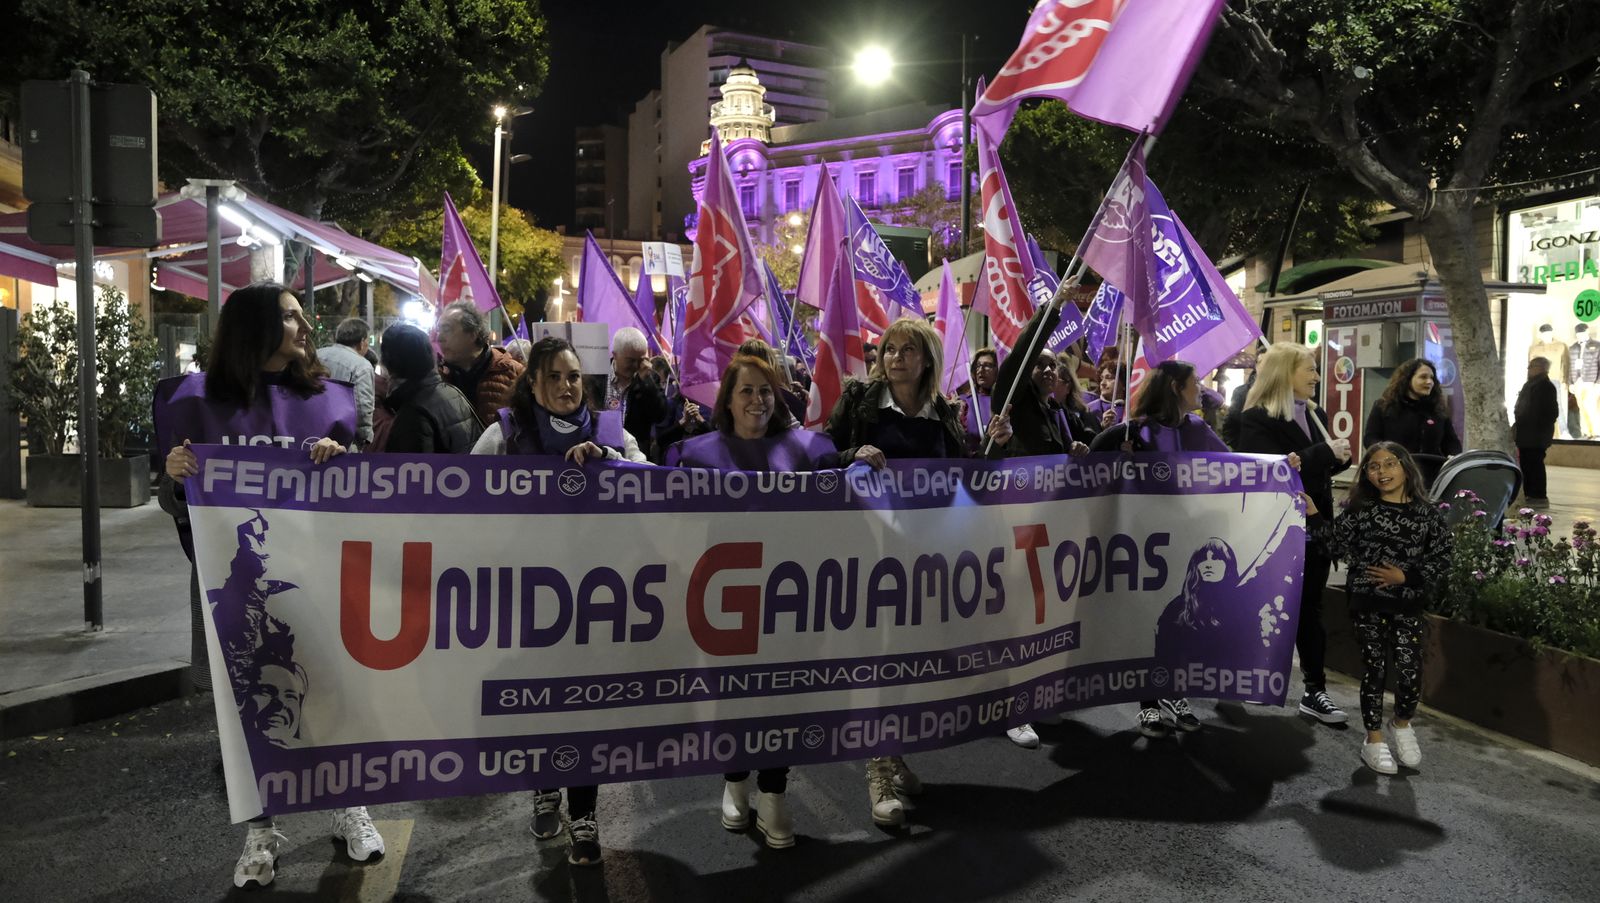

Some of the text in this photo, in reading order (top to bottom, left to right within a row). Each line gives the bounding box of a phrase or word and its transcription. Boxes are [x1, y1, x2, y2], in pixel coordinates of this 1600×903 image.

[1530, 230, 1600, 252] JGONZ
[1333, 301, 1402, 319] FOTOMATON
[203, 458, 1292, 503] FEMINISMO UGT SALARIO UGT IGUALDAD UGT BRECHA UGT RESPETO
[499, 630, 1074, 707] 8M 2023 DÍA INTERNACIONAL DE LA MUJER
[478, 748, 547, 777] UGT
[591, 731, 737, 775] SALARIO
[744, 727, 799, 754] UGT
[831, 704, 972, 756] IGUALDAD
[978, 697, 1015, 725] UGT
[1034, 674, 1104, 711] BRECHA
[1108, 668, 1149, 691] UGT
[1174, 662, 1285, 696] RESPETO
